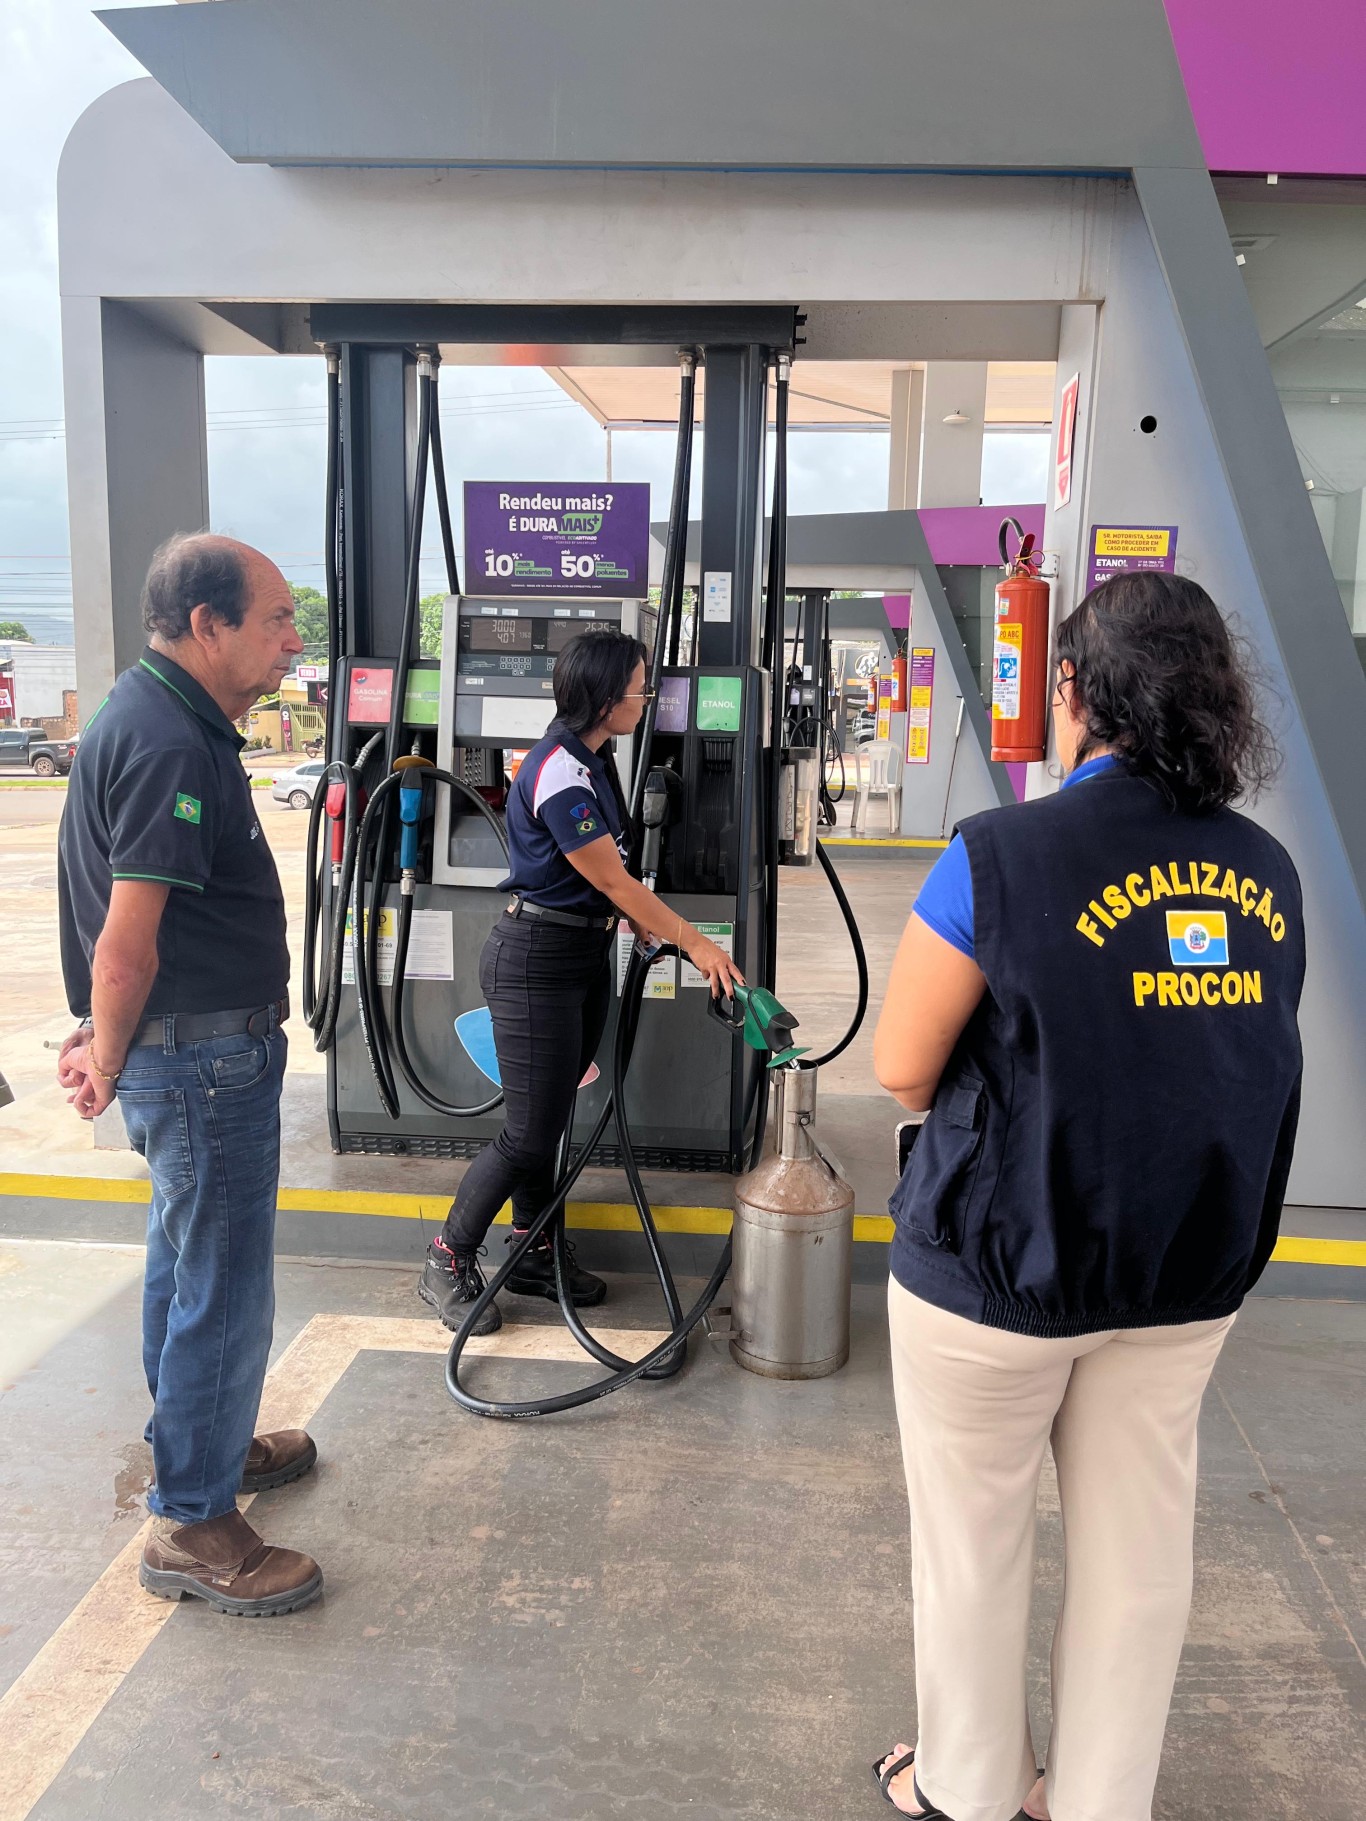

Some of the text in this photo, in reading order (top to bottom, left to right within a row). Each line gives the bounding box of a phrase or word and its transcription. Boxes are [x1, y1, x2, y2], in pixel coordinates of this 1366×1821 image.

[500, 493, 613, 511] Rendeu mais?
[509, 516, 516, 532] É
[1076, 861, 1286, 948] FISCALIZAÇÃO
[1133, 970, 1263, 1007] PROCON
